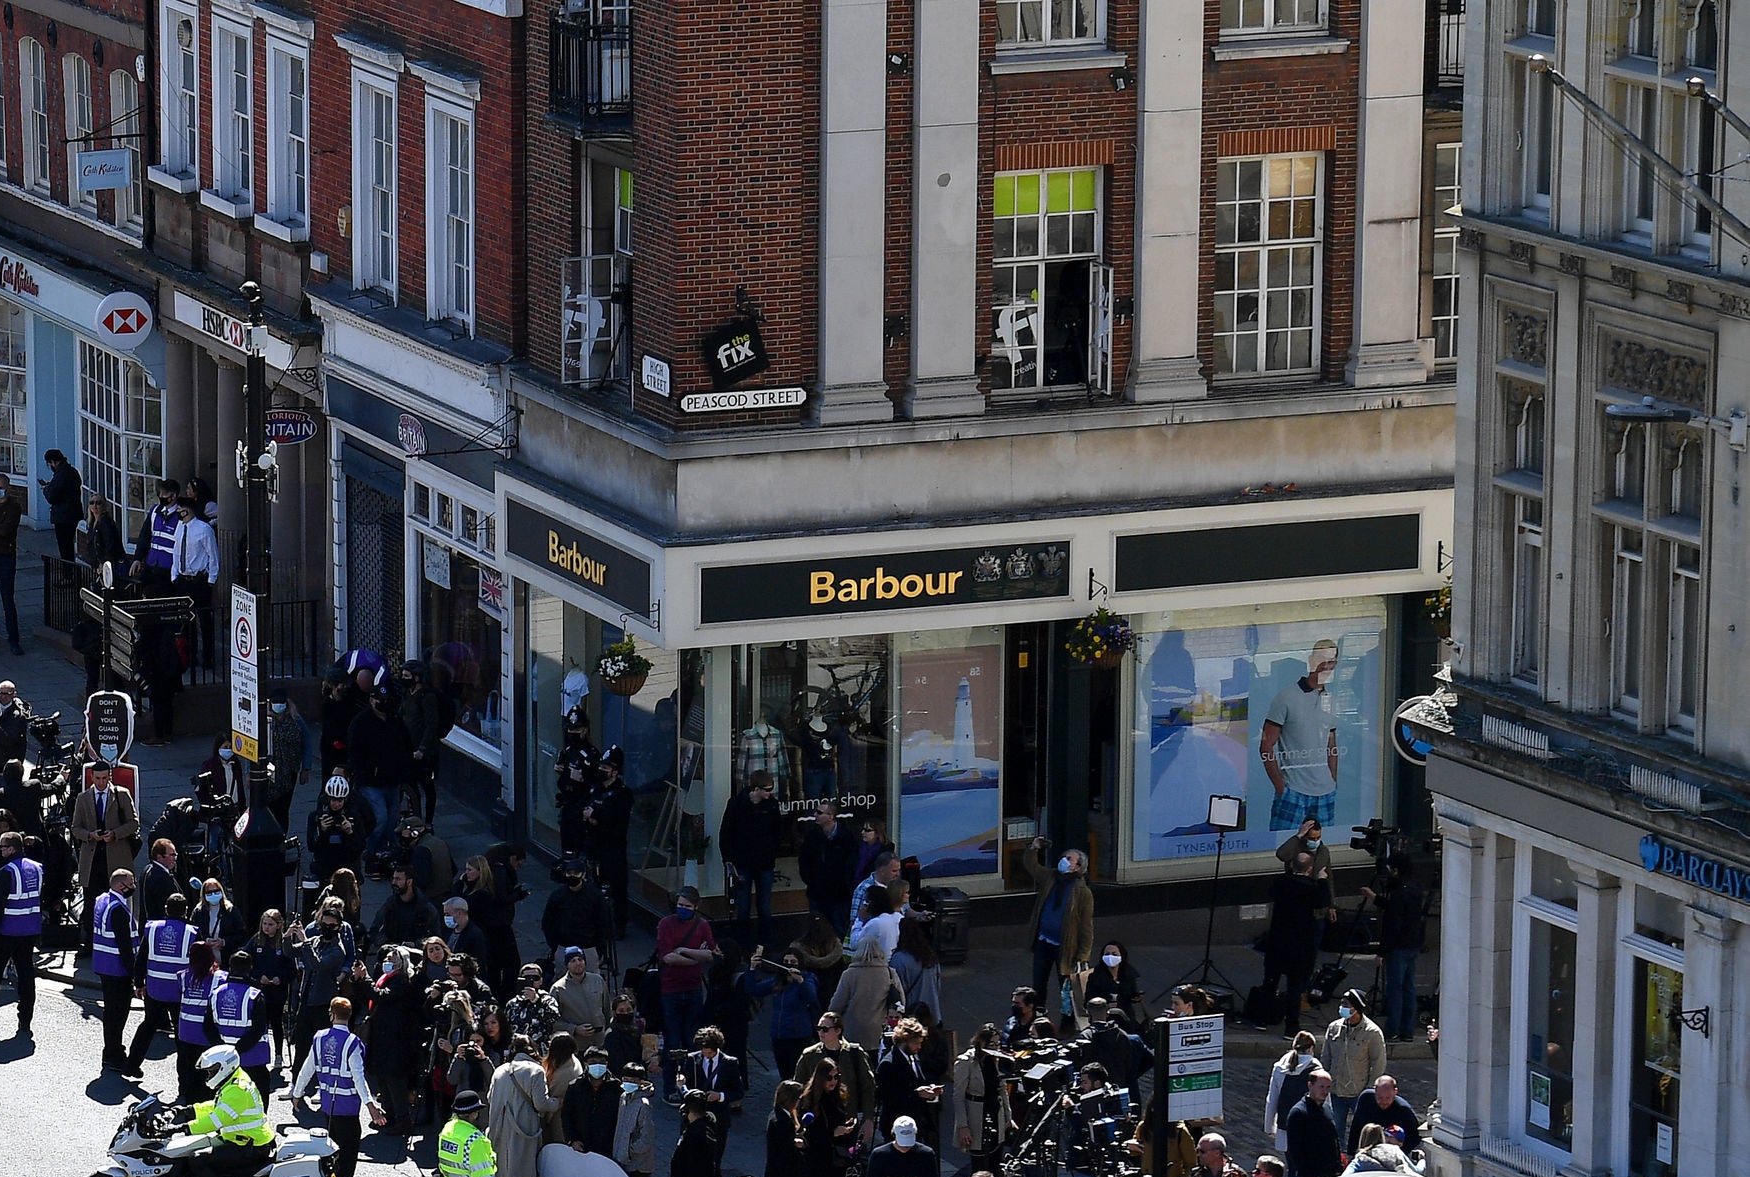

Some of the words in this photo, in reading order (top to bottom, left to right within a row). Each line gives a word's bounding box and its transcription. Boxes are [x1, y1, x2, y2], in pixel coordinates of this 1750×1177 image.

[98, 163, 124, 175] Kidston
[13, 261, 39, 298] Kidston
[202, 307, 230, 340] HSBC
[732, 334, 750, 346] the
[717, 340, 755, 369] fix
[650, 360, 665, 376] HIGH
[646, 374, 667, 393] STREET
[686, 394, 748, 409] PEASCOD
[752, 390, 801, 407] STREET
[266, 412, 306, 422] LORIOUS
[549, 530, 607, 586] Barbour
[810, 567, 964, 604] Barbour
[236, 600, 252, 616] ZONE
[840, 792, 876, 810] shop
[1663, 846, 1750, 903] BARCLAYS
[1178, 1023, 1194, 1031] Bus
[1196, 1021, 1214, 1029] Stop
